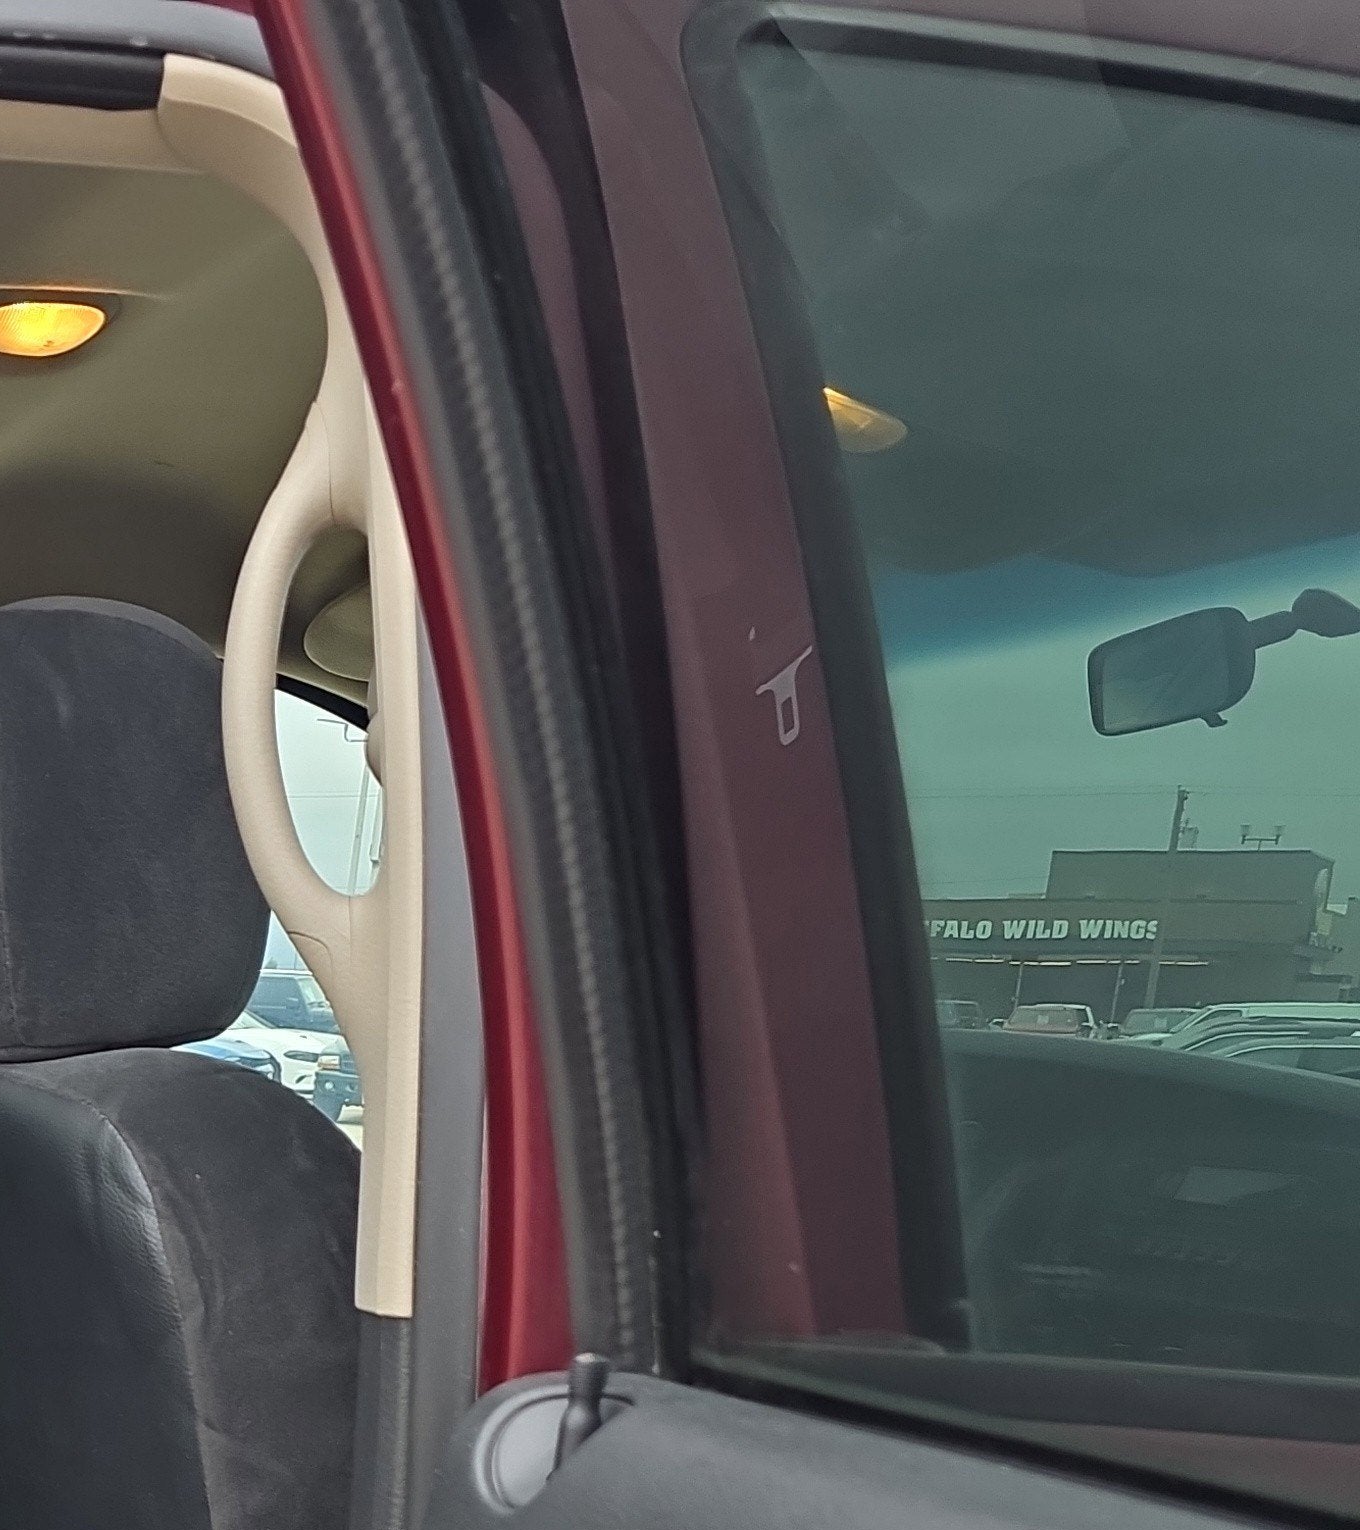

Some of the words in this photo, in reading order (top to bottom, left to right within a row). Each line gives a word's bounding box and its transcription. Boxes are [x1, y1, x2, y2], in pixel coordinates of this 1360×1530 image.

[925, 919, 993, 939] FALO
[1002, 919, 1069, 939] WILD
[1079, 919, 1159, 940] WINGS
